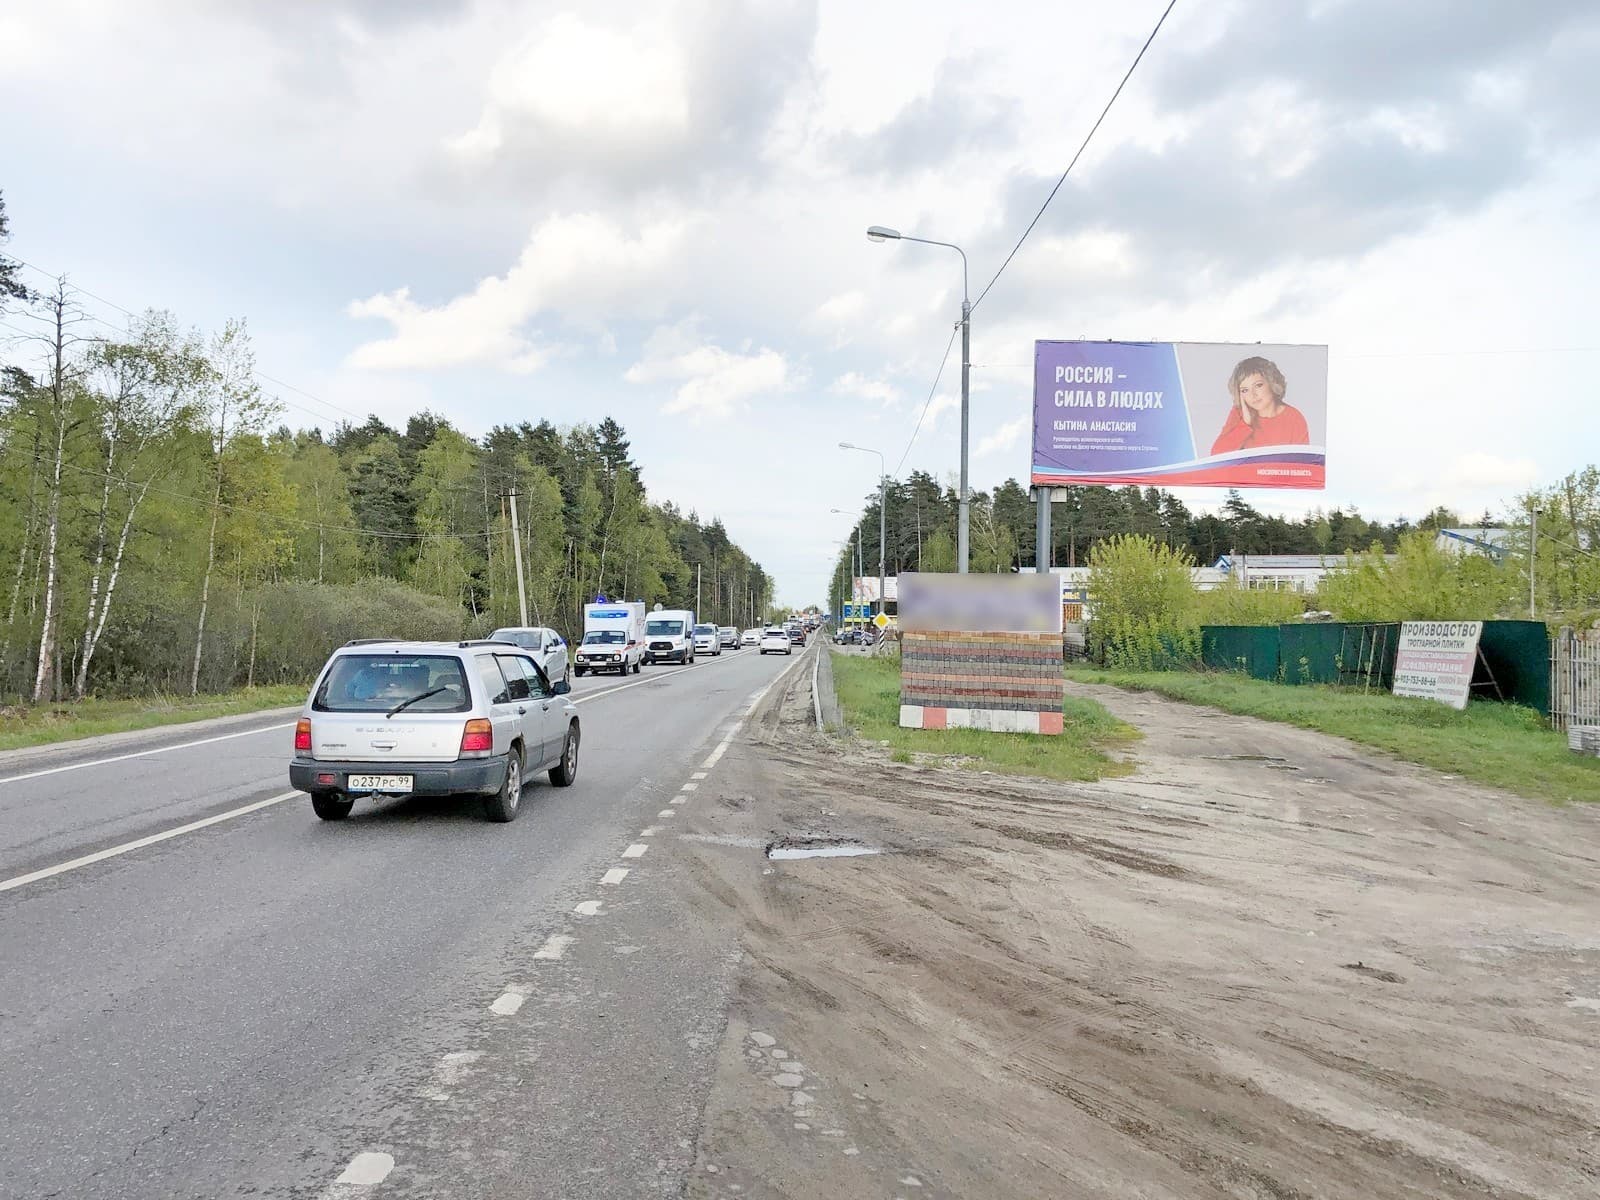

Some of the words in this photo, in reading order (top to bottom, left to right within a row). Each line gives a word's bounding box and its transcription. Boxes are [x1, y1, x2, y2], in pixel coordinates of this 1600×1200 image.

[1055, 366, 1113, 384] РОССИЯ
[1054, 390, 1094, 408] СИЛА
[1096, 391, 1106, 408] В
[1108, 391, 1163, 410] ЛЮДЯХ
[1053, 420, 1087, 431] КЫТИНА
[1090, 421, 1137, 432] АНАСТАСИЯ
[1401, 623, 1477, 637] ПРОИЗВОДСТВО
[1407, 638, 1440, 649] ТРОТУАРНОЙ
[1441, 640, 1465, 649] ПЛИТКИ
